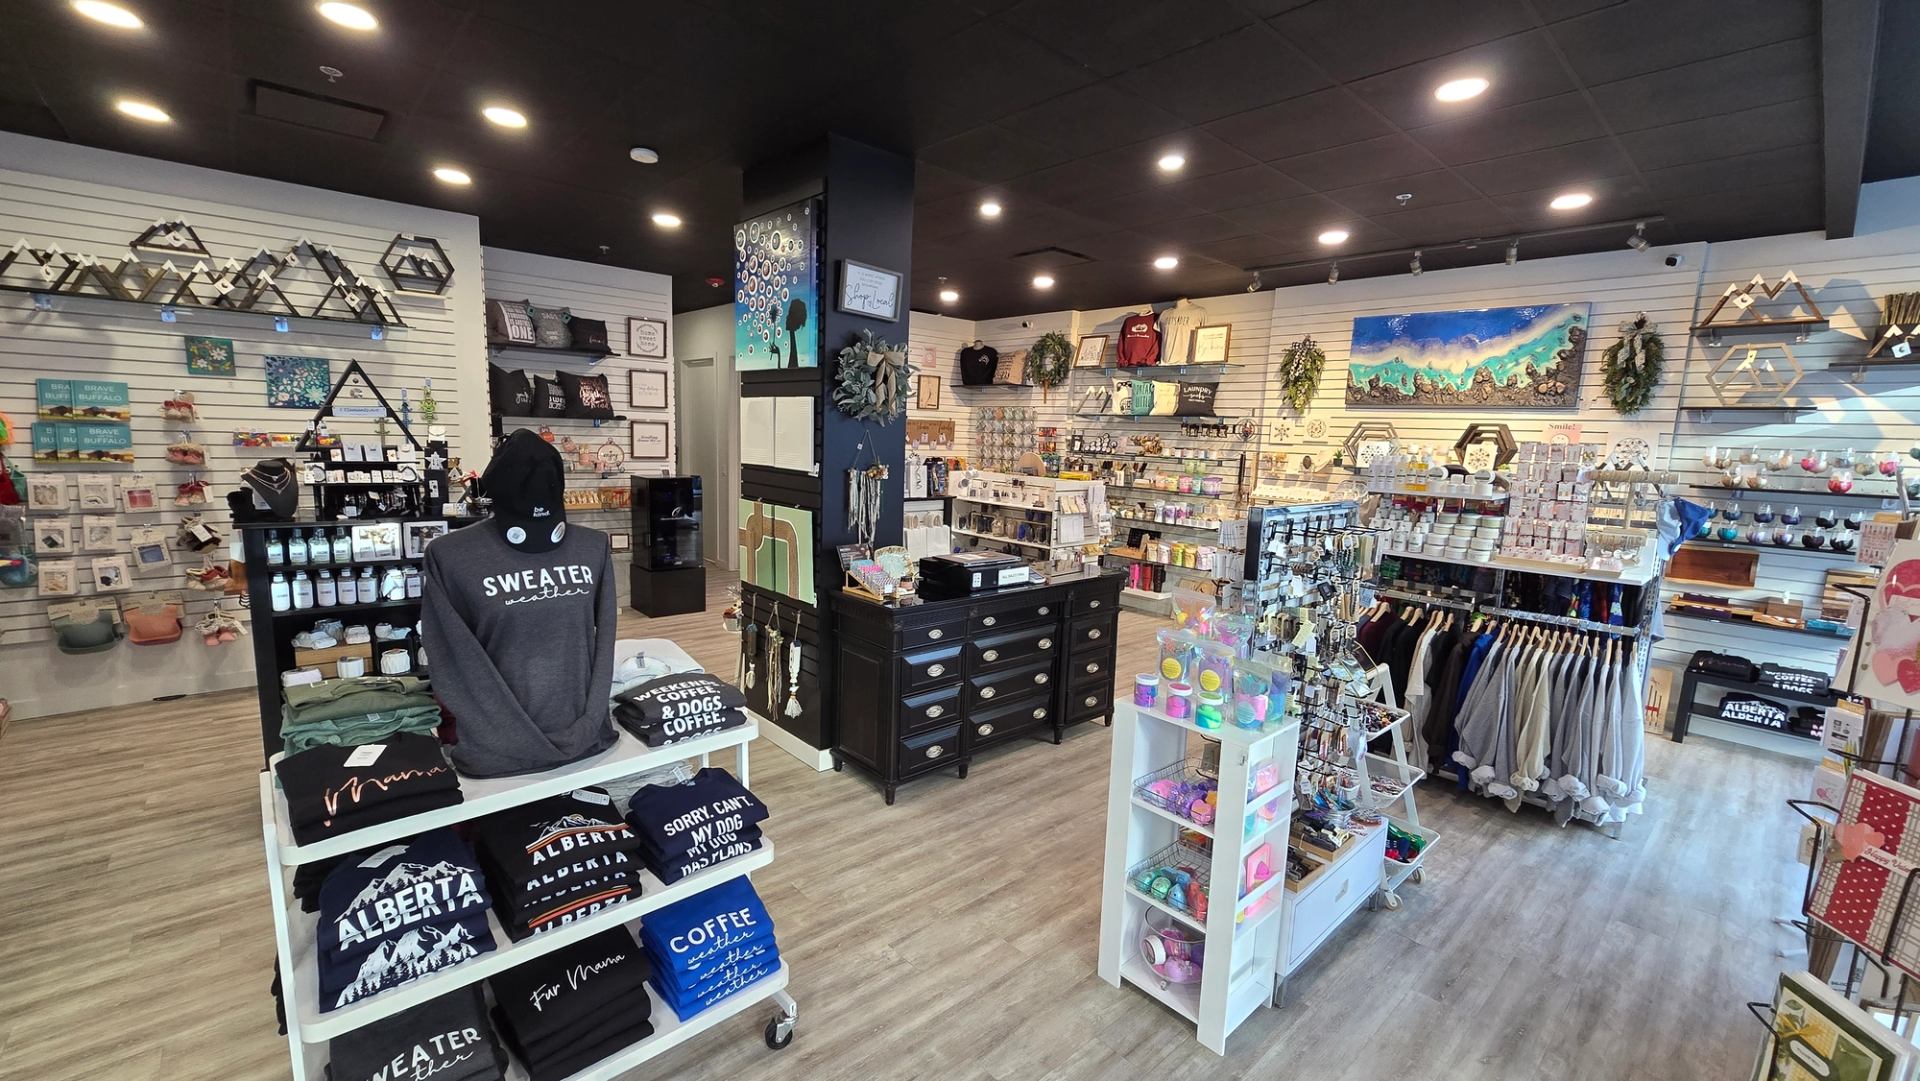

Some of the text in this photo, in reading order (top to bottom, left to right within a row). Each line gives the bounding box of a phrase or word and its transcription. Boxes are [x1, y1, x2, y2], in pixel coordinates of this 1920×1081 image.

[845, 283, 894, 309] Shop Local
[511, 325, 534, 340] ONE
[78, 393, 122, 401] BUFFALO
[1183, 386, 1213, 396] LAUNDRY
[1549, 423, 1577, 431] Smile!
[482, 565, 594, 598] SWEATER
[505, 585, 590, 606] weather
[656, 684, 721, 703] COFFEE.
[661, 695, 728, 720] & DOGS.
[663, 711, 728, 738] COFFEE.
[1724, 703, 1786, 721] ALBERTA
[663, 795, 754, 838] SORRY. CAN'T.
[690, 814, 744, 848] MY DOG
[532, 829, 635, 866] ALBERTA
[339, 872, 478, 944] ALBERTA
[669, 907, 758, 954] COFFEE
[687, 929, 755, 965] weather
[700, 943, 765, 980] weather
[529, 952, 626, 1011] Fur Mama
[697, 961, 763, 999] weather
[704, 966, 769, 1006] weather
[366, 1027, 483, 1081] WEATER
